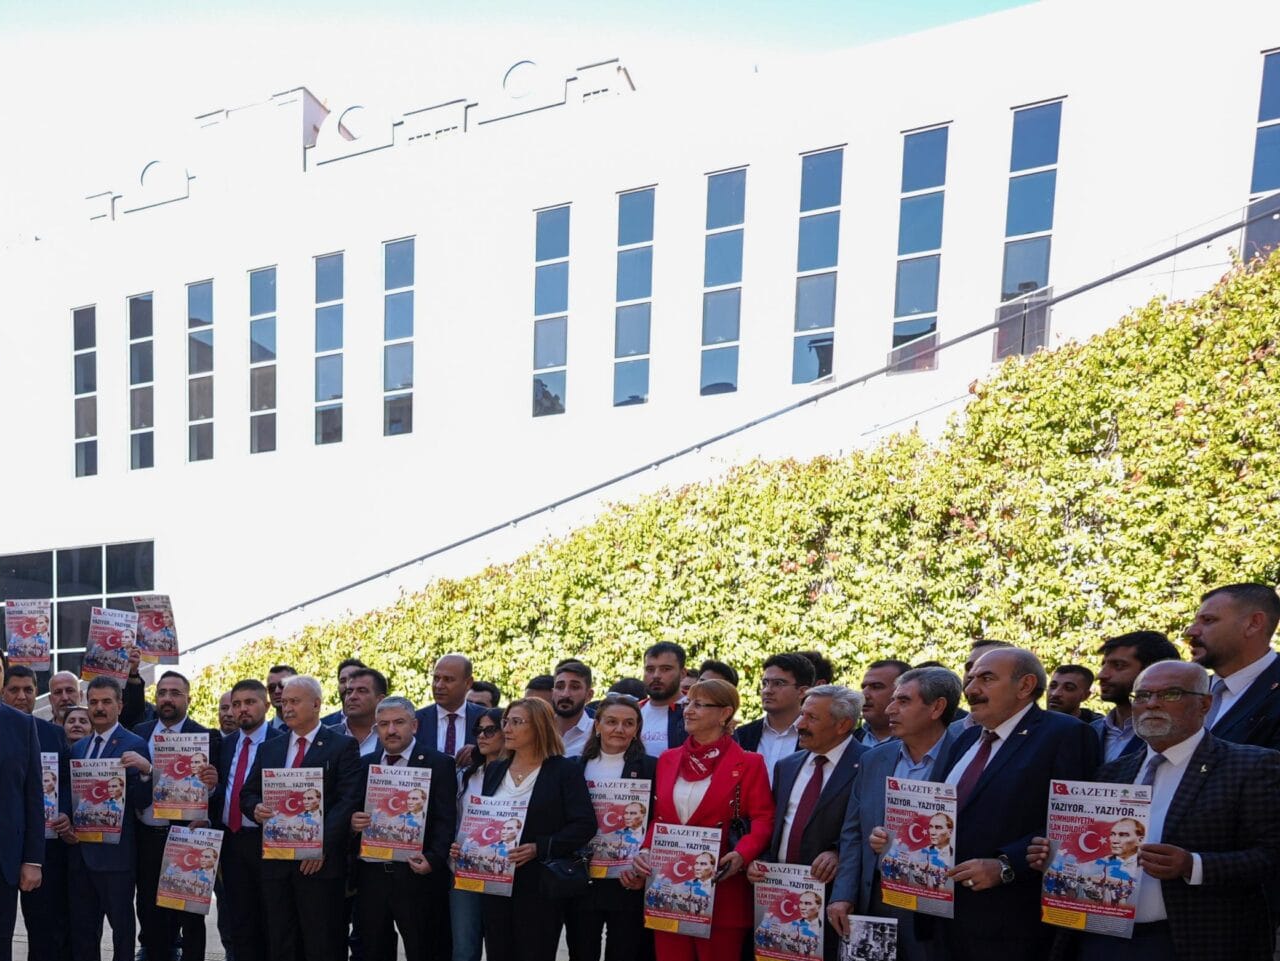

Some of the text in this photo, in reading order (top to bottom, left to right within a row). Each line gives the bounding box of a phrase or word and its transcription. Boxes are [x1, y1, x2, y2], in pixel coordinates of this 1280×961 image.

[597, 781, 629, 789] GAZETE
[901, 783, 933, 795] GAZETE
[1071, 786, 1118, 798] GAZETE
[670, 828, 701, 838] GAZETE
[770, 866, 801, 875] GAZETE
